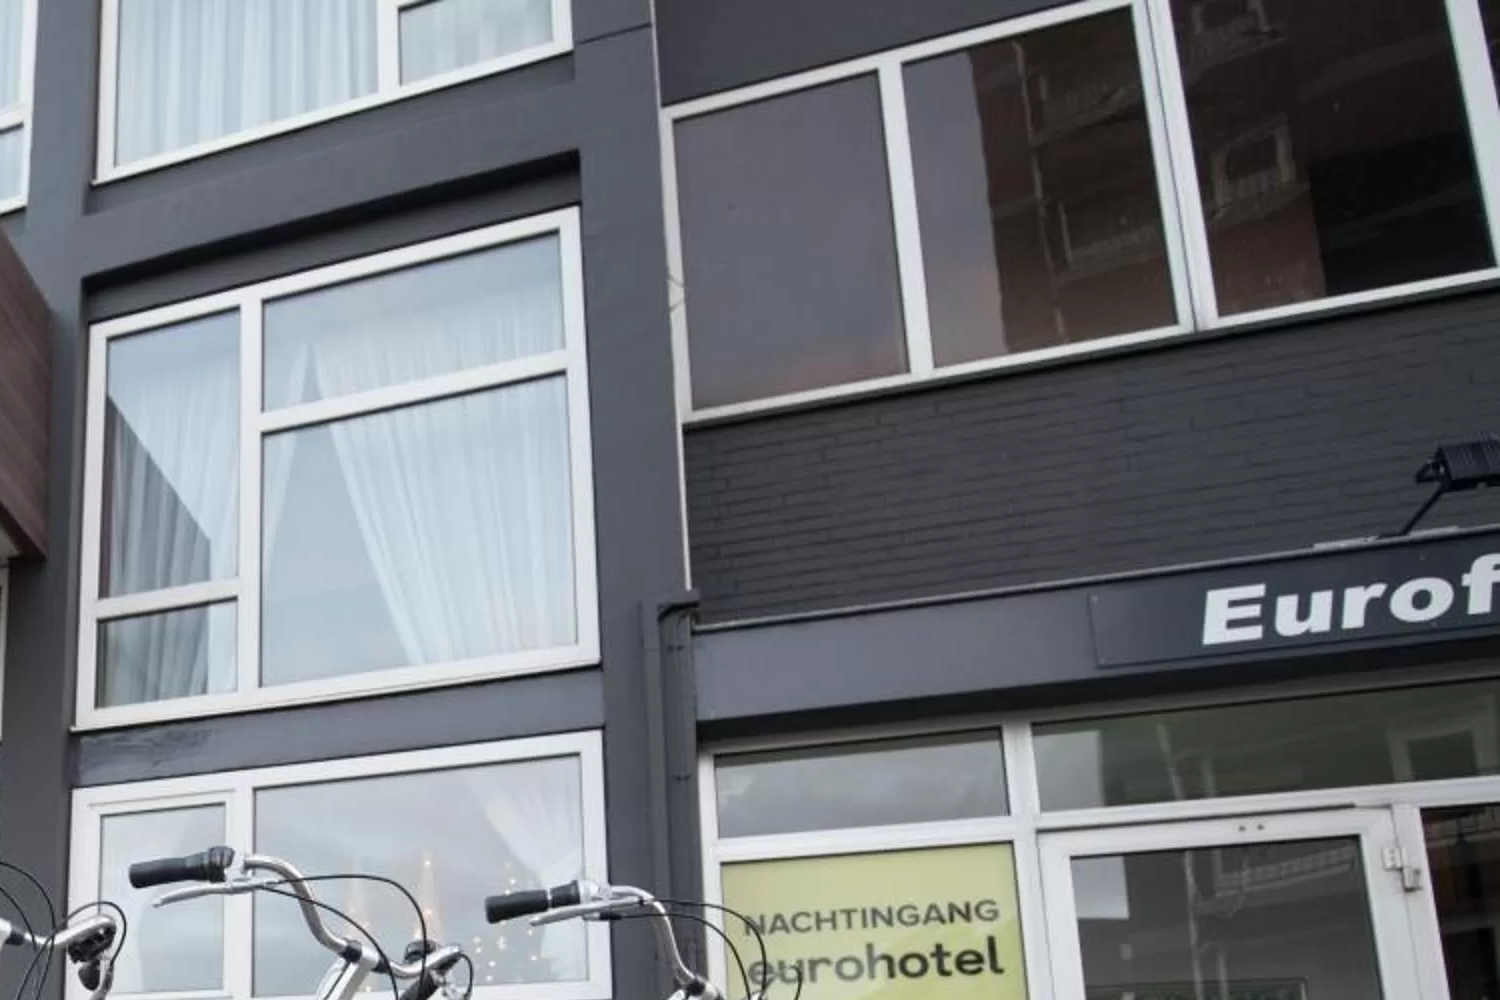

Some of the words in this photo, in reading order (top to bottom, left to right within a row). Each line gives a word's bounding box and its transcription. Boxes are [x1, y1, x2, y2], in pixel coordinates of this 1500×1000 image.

[1202, 552, 1500, 646] Eurof
[745, 899, 1000, 937] NACHTINGANG
[748, 935, 1005, 984] eurohotel
